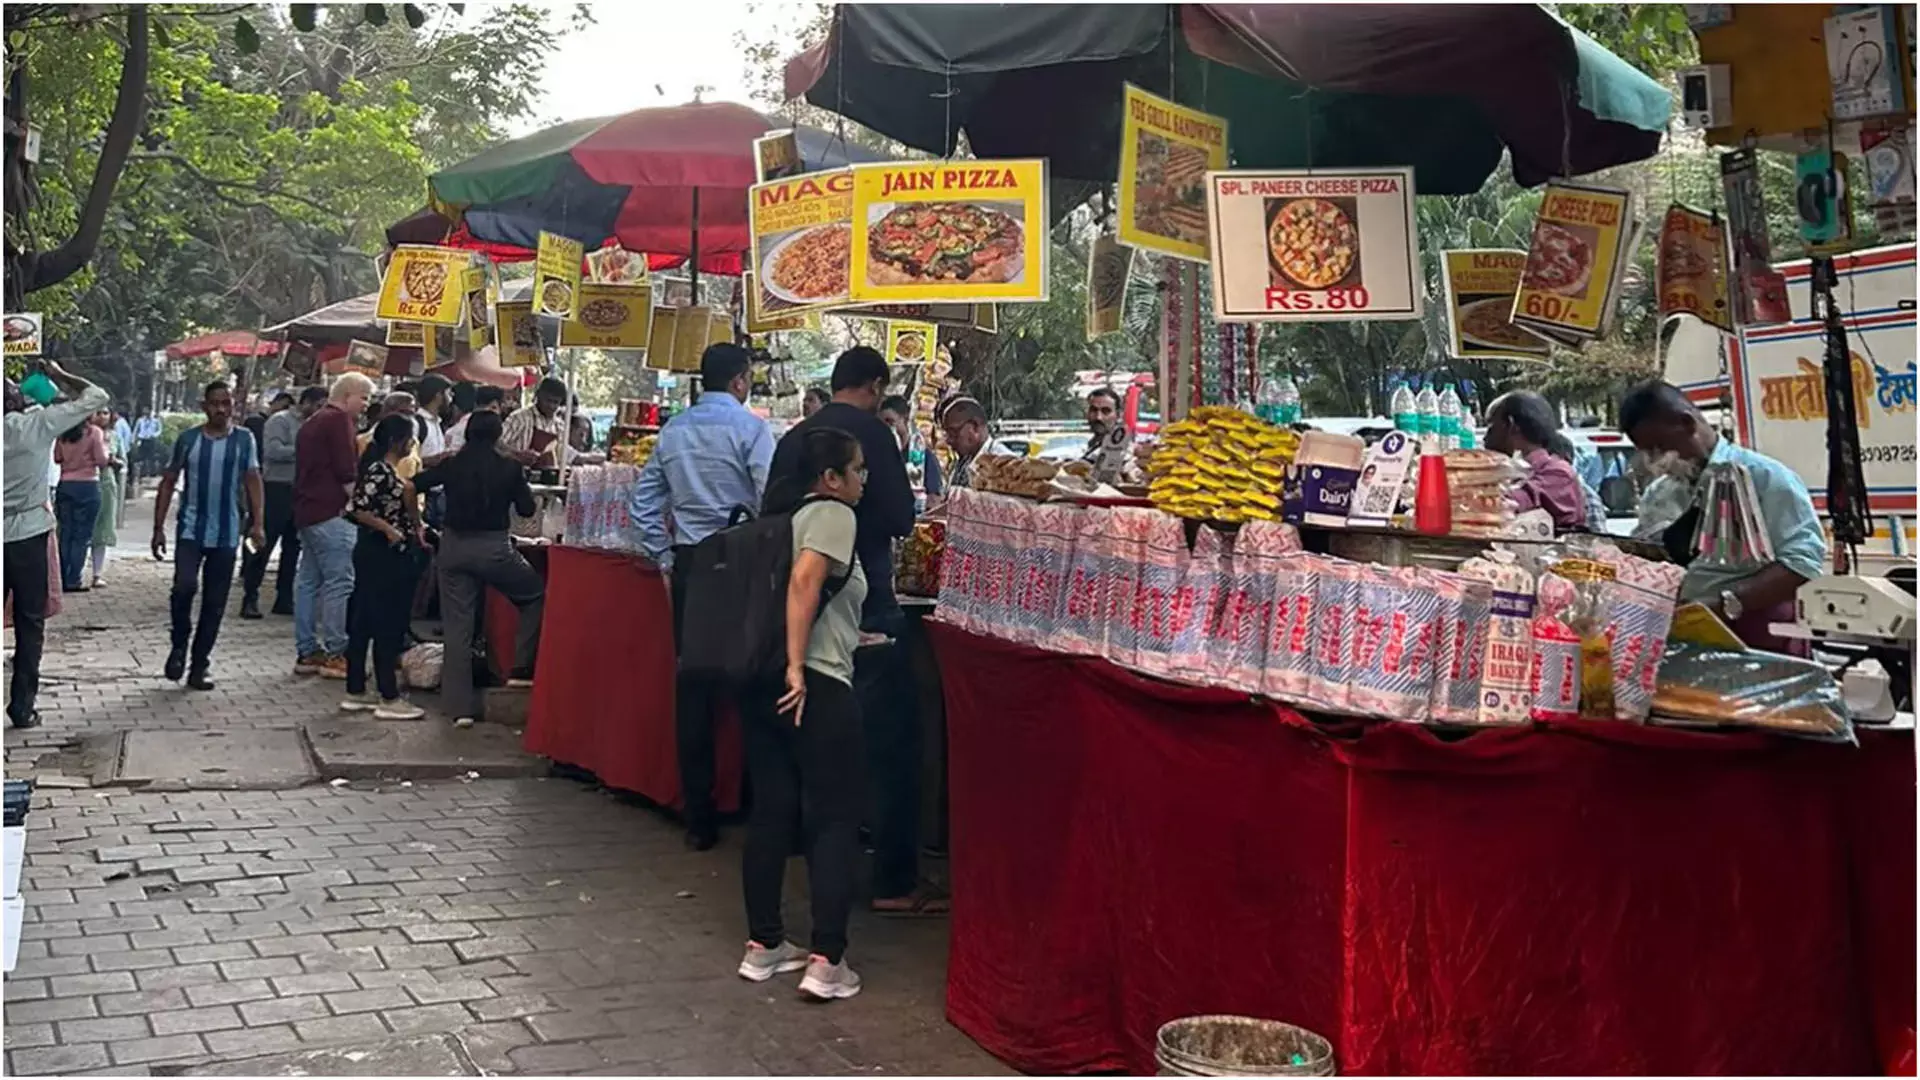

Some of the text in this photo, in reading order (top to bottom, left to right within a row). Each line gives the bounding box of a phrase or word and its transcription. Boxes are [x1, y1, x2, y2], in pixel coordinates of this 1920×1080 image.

[882, 168, 1017, 196] JAIN PIZZA
[1221, 179, 1398, 195] SPL. PANEER CHEESE PIZZA
[1551, 195, 1620, 226] CHEESE PIZZA
[1265, 287, 1369, 309] Rs.80
[1525, 294, 1580, 321] 60/-
[420, 303, 438, 317] 60
[1319, 487, 1350, 507] Dairy
